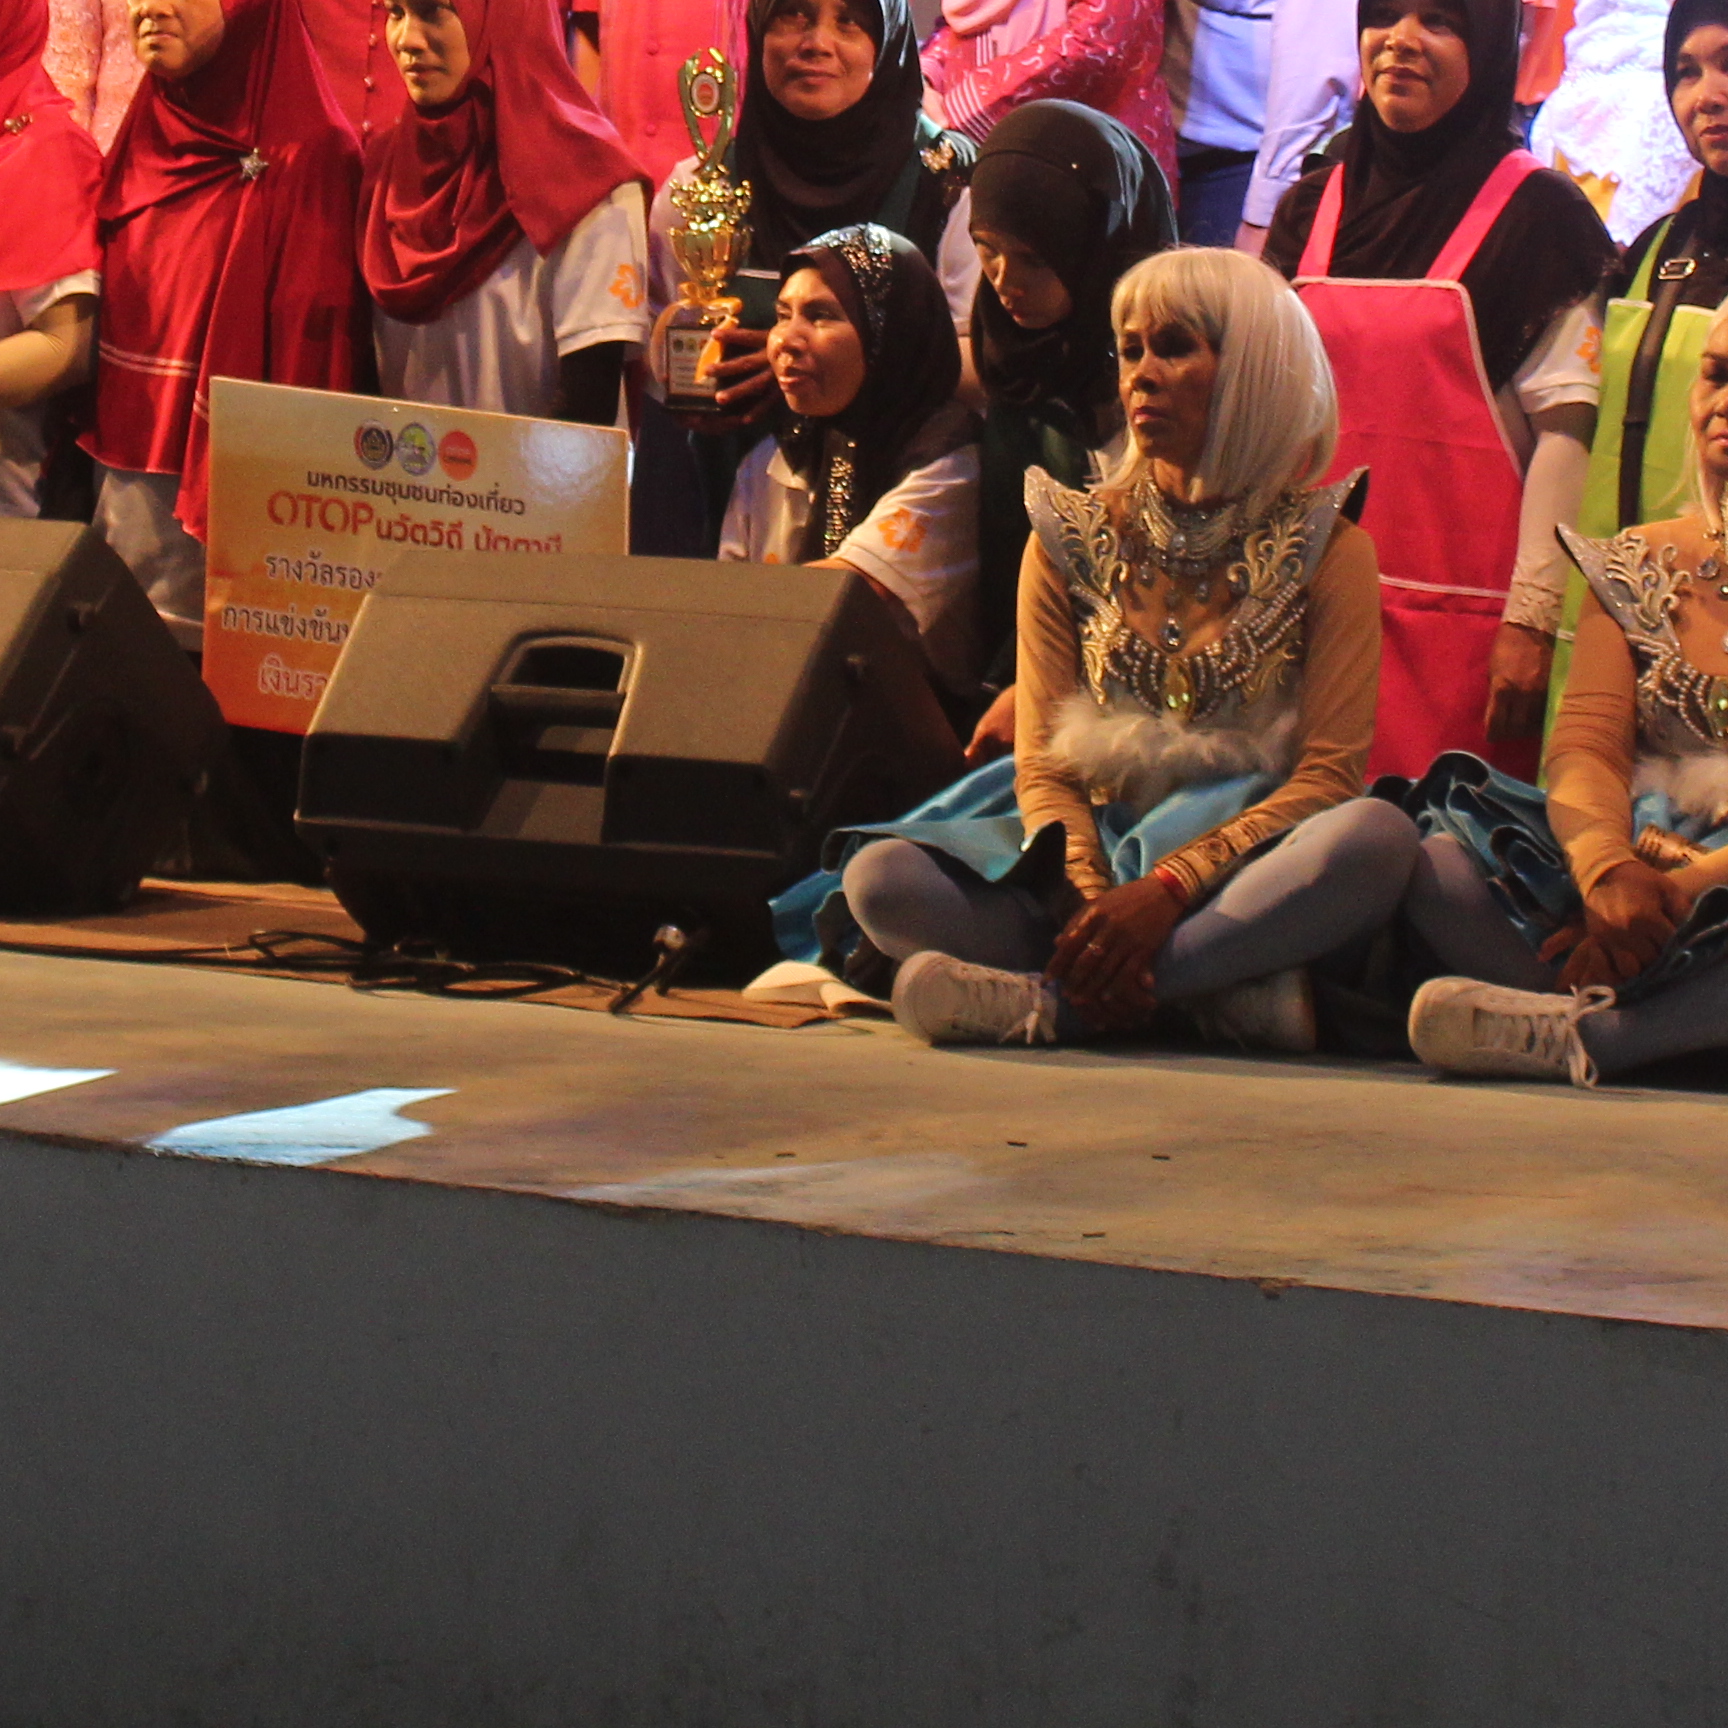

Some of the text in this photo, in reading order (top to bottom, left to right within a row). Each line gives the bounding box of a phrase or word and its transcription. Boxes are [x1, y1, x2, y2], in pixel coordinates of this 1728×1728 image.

[306, 471, 525, 515] มหกรรมชุมชนท่องเที่ยว
[267, 490, 374, 536] OTOP
[375, 514, 464, 550] นวัตวิถี
[265, 551, 380, 589] รางวัลรอง
